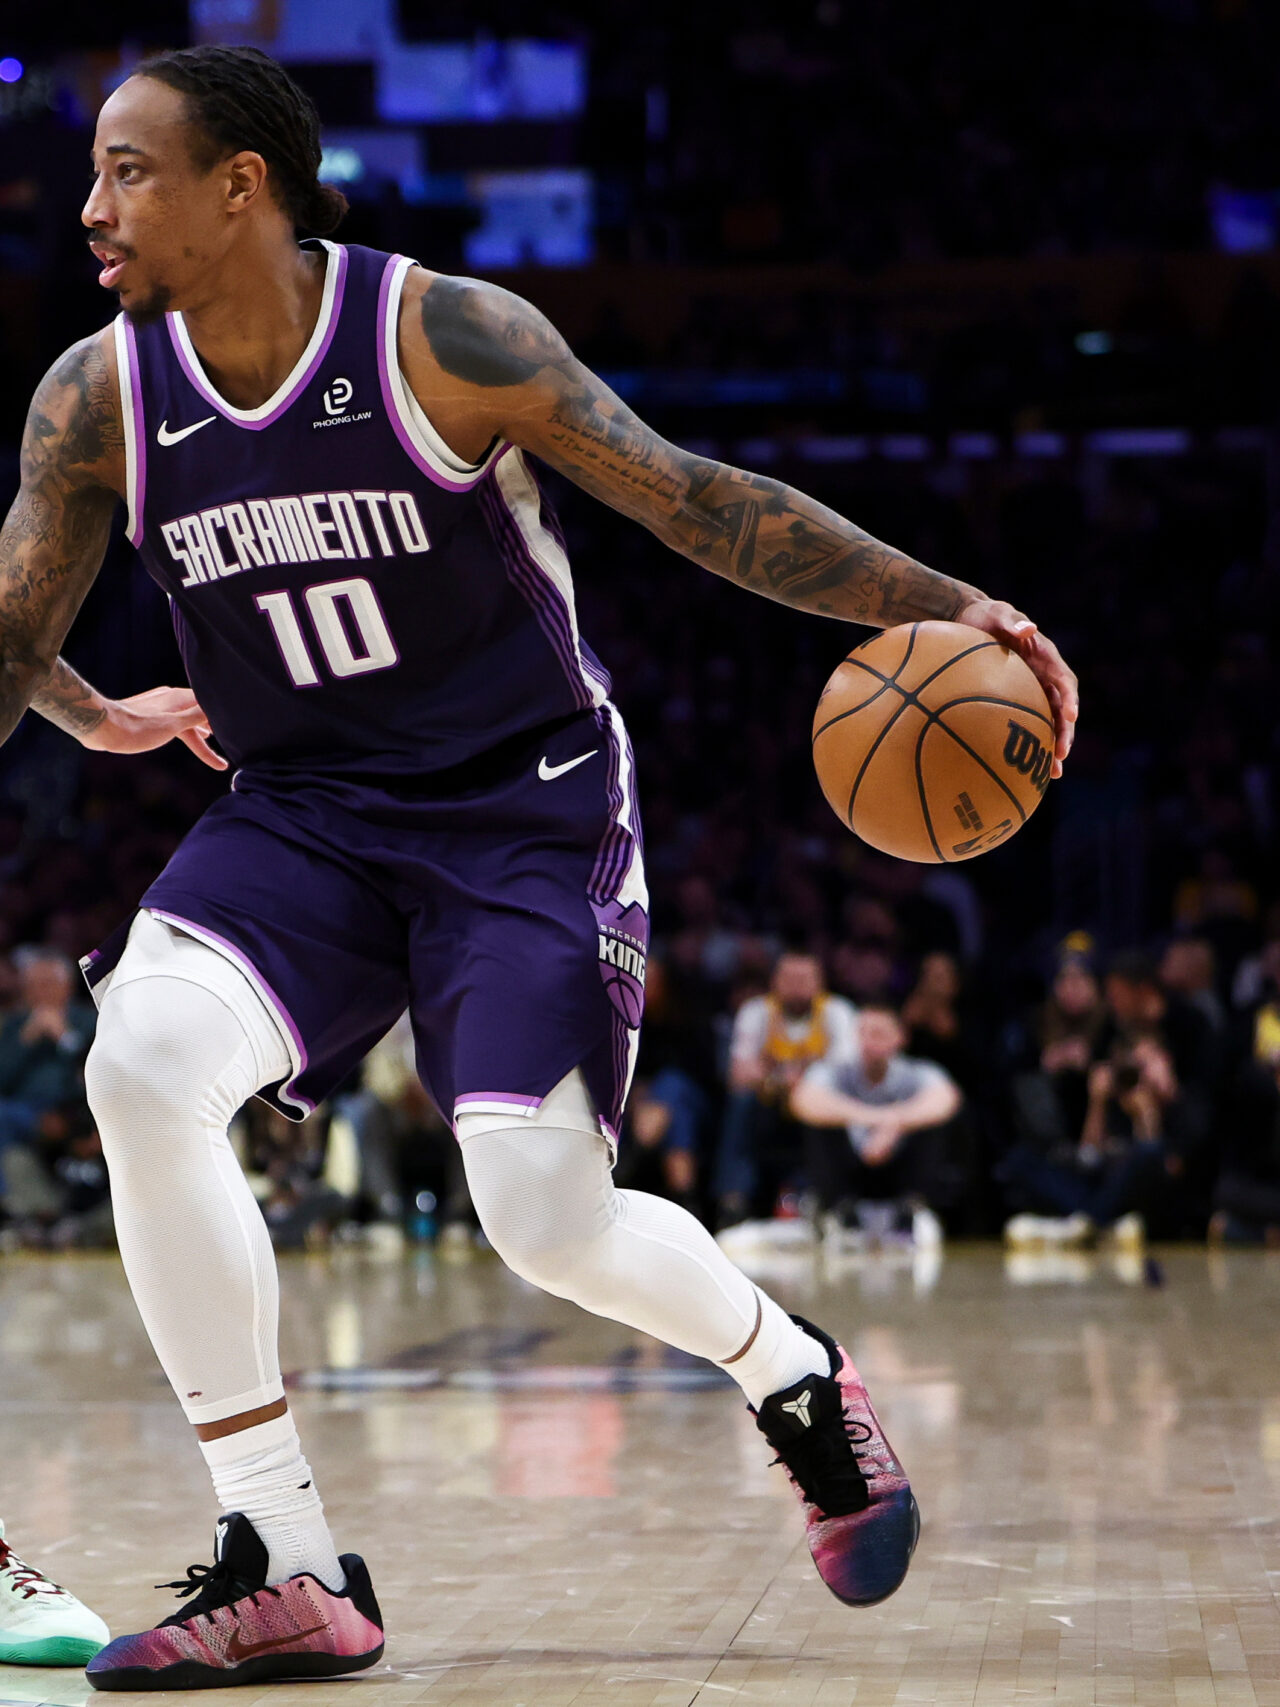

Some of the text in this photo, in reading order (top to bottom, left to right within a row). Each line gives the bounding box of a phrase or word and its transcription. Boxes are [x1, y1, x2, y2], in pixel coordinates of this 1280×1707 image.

[313, 411, 372, 429] PHOONG LAW
[160, 490, 431, 589] SACRAMENTO
[253, 577, 402, 689] 10
